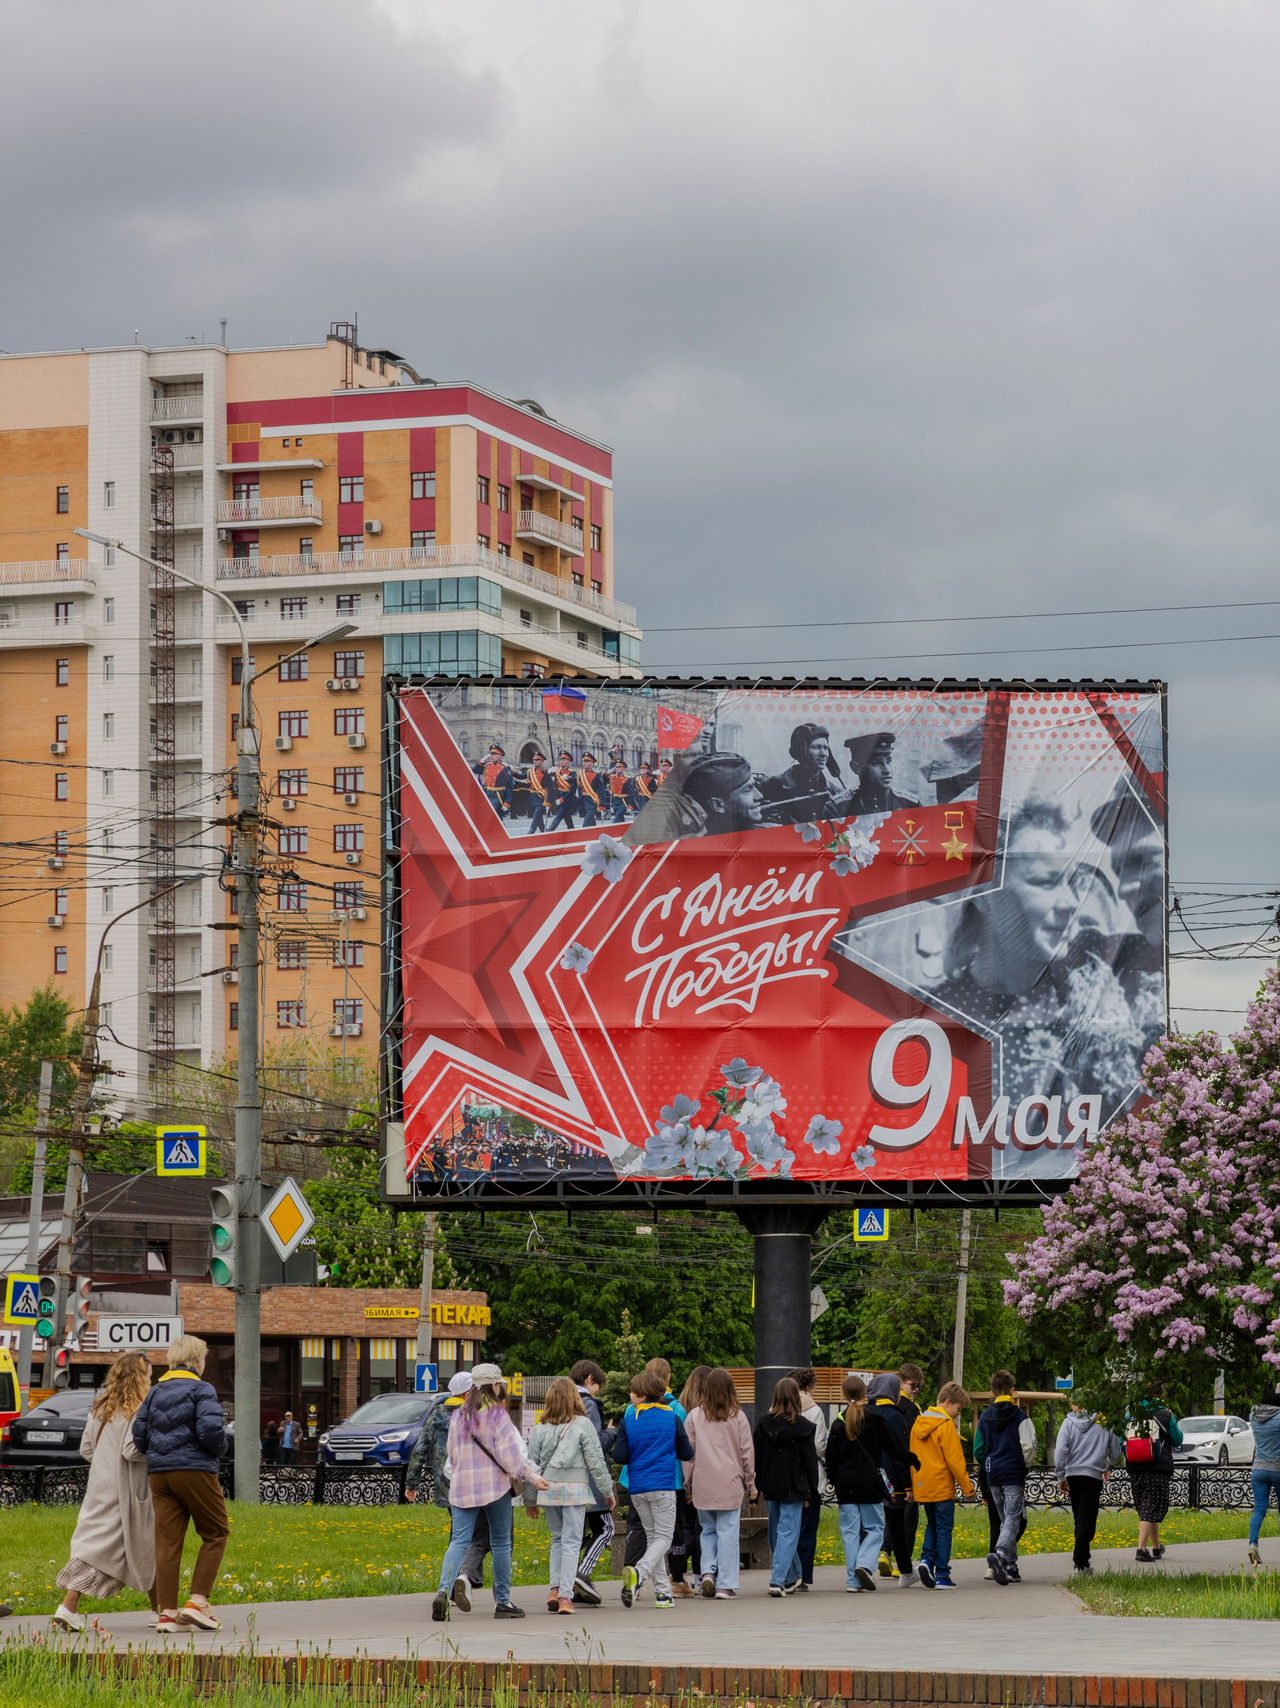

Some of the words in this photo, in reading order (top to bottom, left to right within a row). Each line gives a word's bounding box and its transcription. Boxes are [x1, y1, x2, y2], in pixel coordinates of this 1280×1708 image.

[631, 887, 682, 954] С
[678, 866, 824, 938] Днём
[624, 910, 841, 1028] Победы!
[868, 1018, 953, 1147] 9
[953, 1094, 1102, 1145] мая
[41, 1301, 55, 1313] 04
[109, 1323, 170, 1343] СТОП
